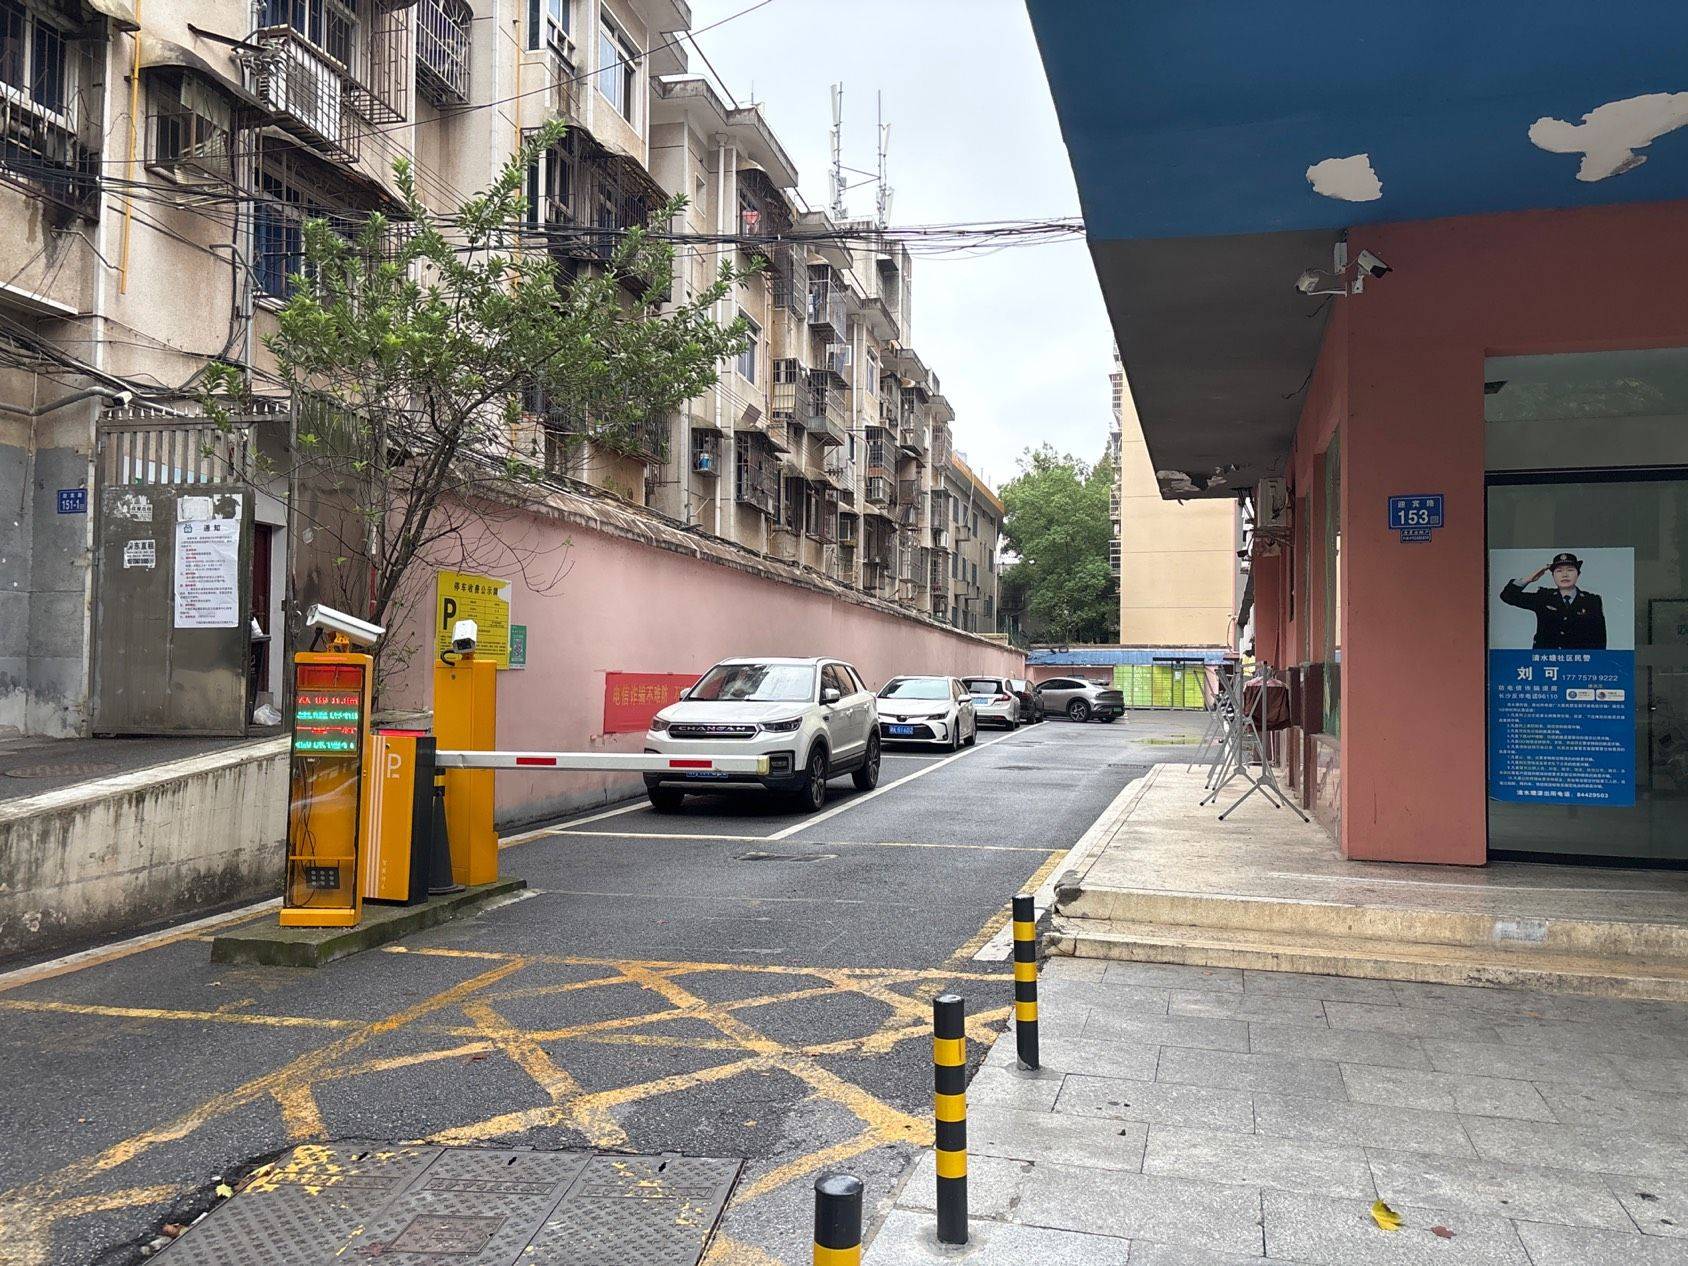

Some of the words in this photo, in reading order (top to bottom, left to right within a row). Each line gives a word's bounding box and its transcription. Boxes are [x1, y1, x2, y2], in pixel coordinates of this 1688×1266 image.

[62, 499, 80, 510] 151-1
[1397, 499, 1435, 508] 迎宾路
[1398, 509, 1429, 524] 153
[203, 524, 221, 532] 通知
[443, 597, 457, 630] P
